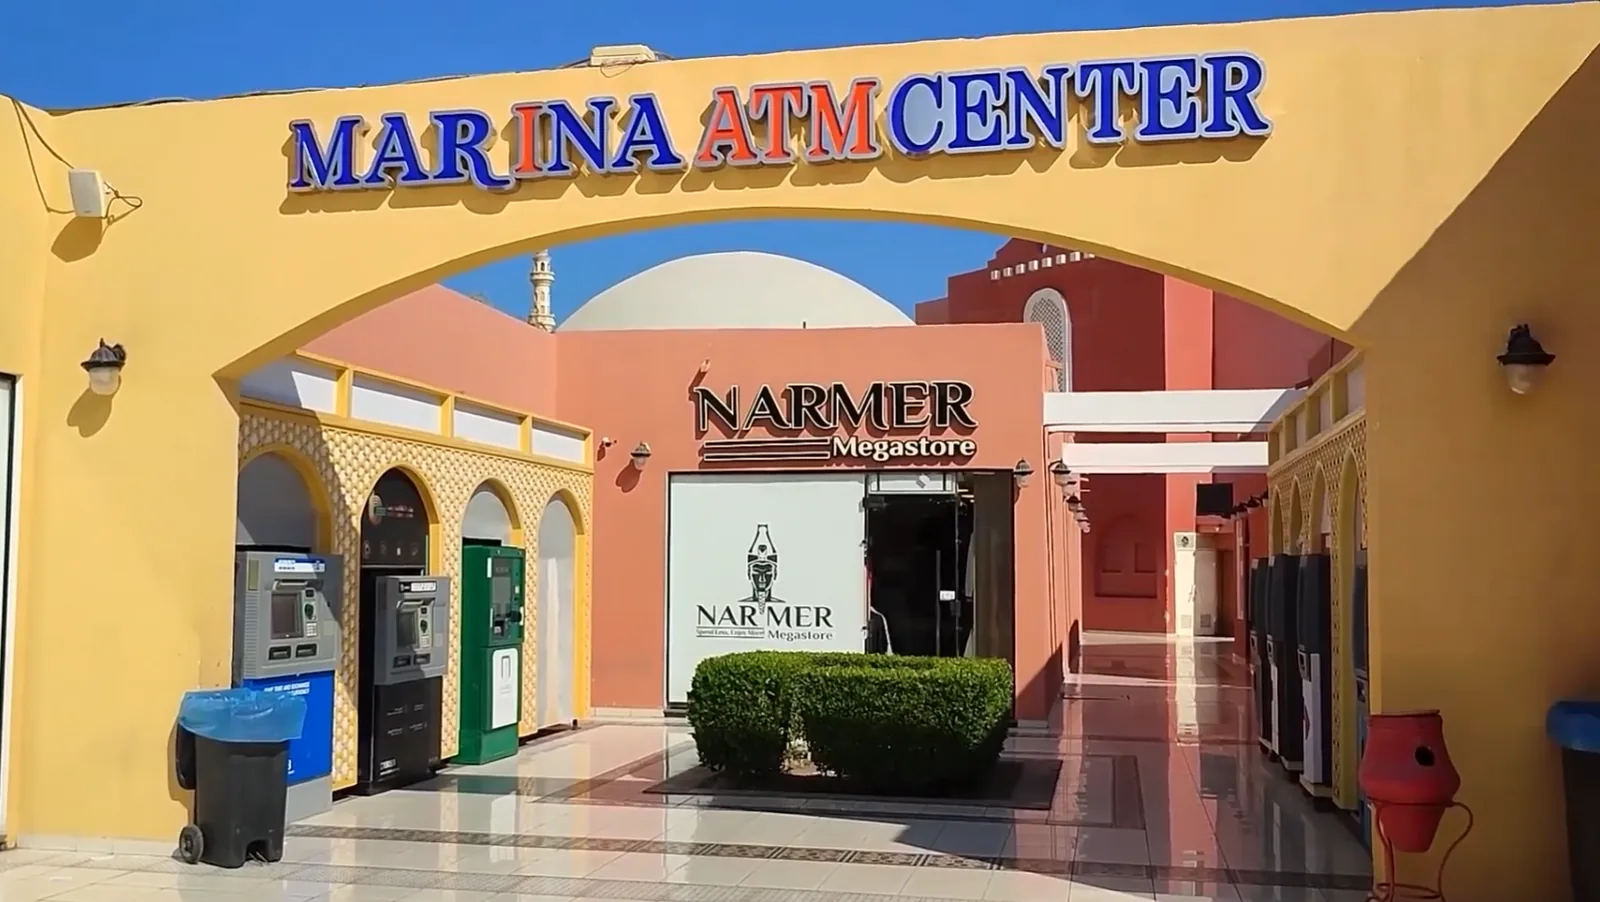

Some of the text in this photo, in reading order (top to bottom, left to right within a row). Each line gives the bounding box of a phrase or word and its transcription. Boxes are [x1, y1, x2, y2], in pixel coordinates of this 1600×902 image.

[288, 51, 1272, 191] MARINA ATM CENTER
[694, 381, 978, 431] NARMER
[833, 437, 976, 462] Megastore
[768, 630, 833, 642] Megastore
